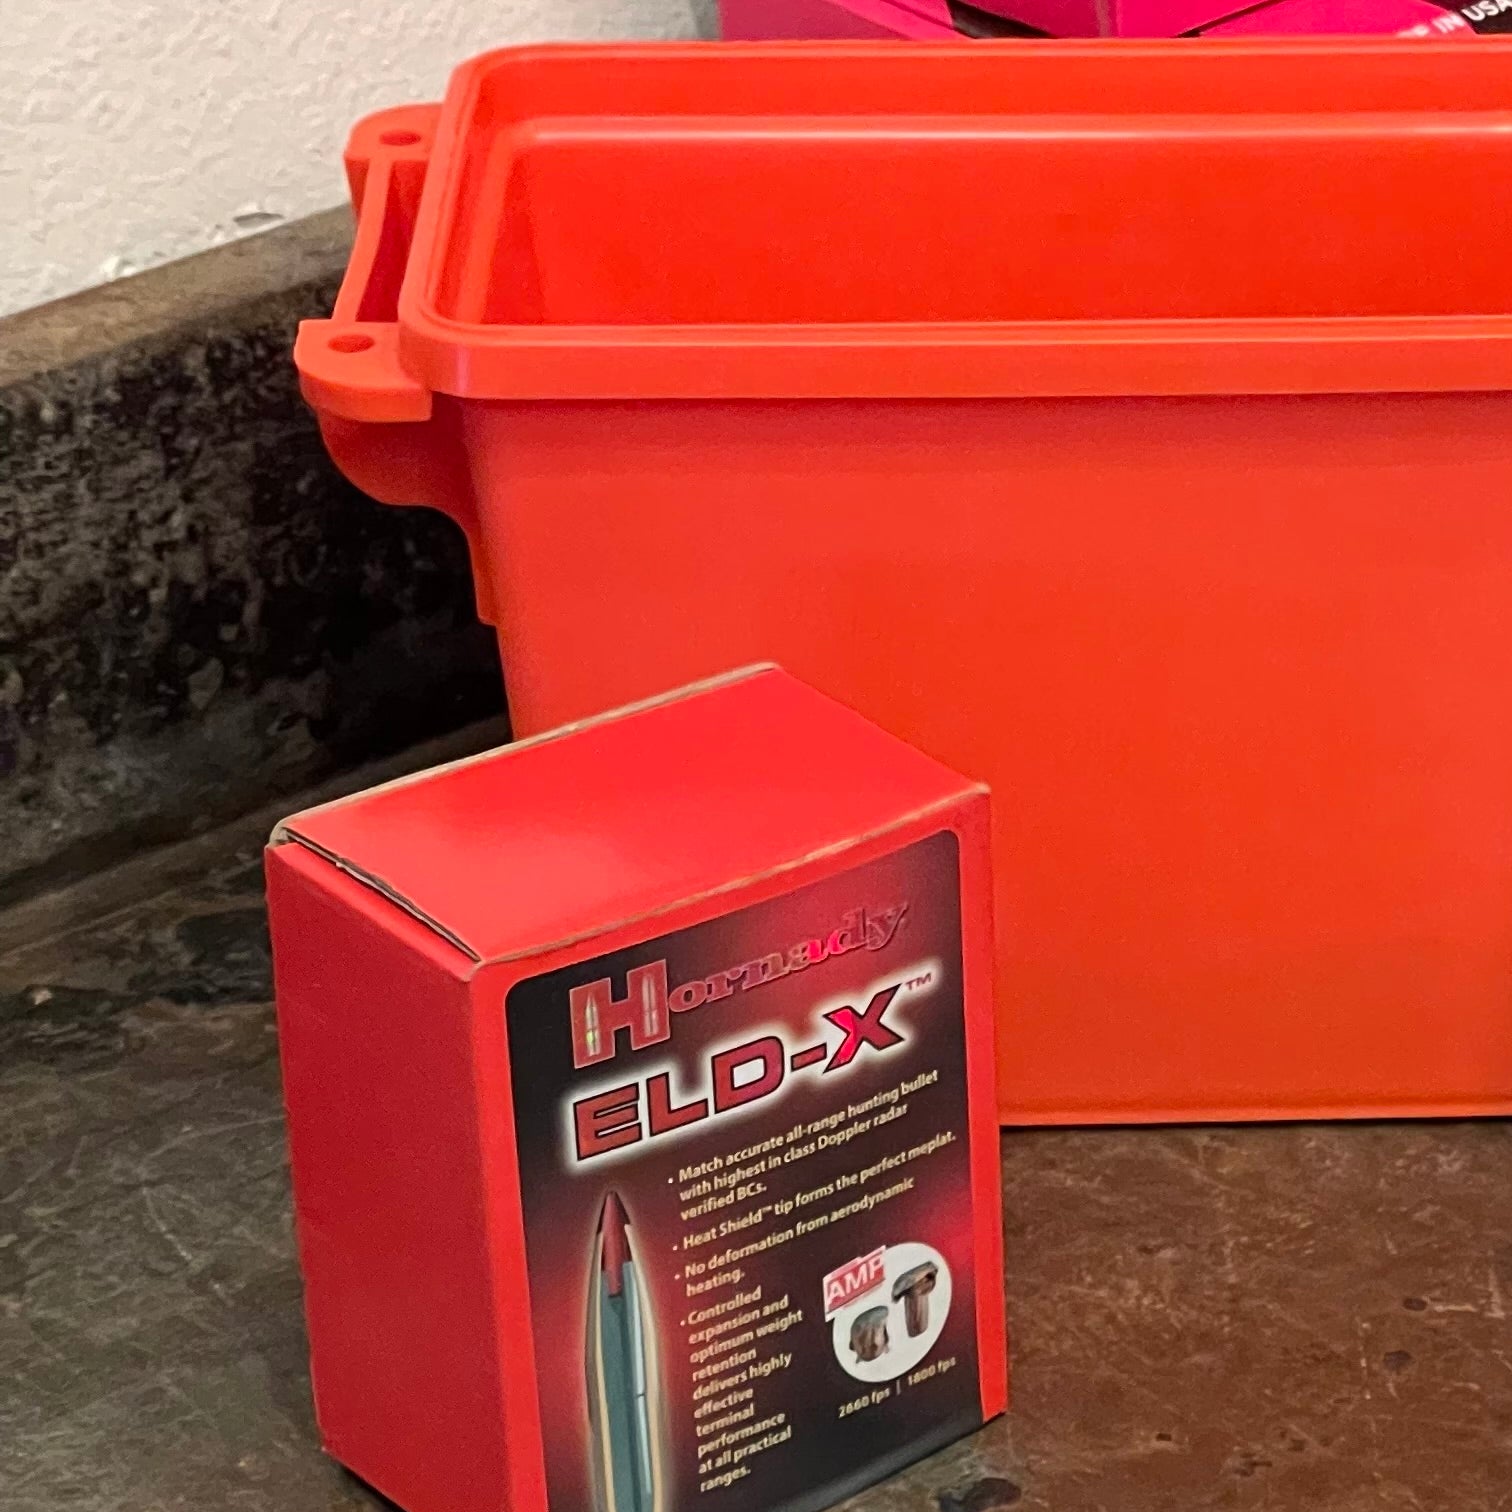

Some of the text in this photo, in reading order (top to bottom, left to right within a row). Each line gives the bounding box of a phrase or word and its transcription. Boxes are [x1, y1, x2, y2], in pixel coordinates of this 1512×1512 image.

[679, 1069, 938, 1184] Match accurate all-range hunting bullet
[680, 1103, 908, 1202] with highest in class Doppler radar
[680, 1183, 767, 1221] verified BCs.
[683, 1227, 717, 1250] Heat
[774, 1198, 793, 1218] tip
[795, 1182, 834, 1208] forms
[836, 1170, 858, 1190] the
[860, 1152, 906, 1184] perfect
[908, 1130, 957, 1161] meplat.
[685, 1176, 914, 1279] No deformation from aerodynamic
[686, 1268, 745, 1298] heating.
[827, 1255, 885, 1301] AMP
[688, 1285, 762, 1325] Controlled
[688, 1293, 789, 1345] expansion and
[690, 1309, 803, 1364] optimum weight
[692, 1347, 757, 1382] retention
[693, 1352, 793, 1401] delivers highly
[693, 1387, 754, 1419] effective
[696, 1402, 755, 1437] terminal
[698, 1411, 786, 1459] performance
[699, 1424, 793, 1475] at all practical
[700, 1464, 751, 1493] ranges.
